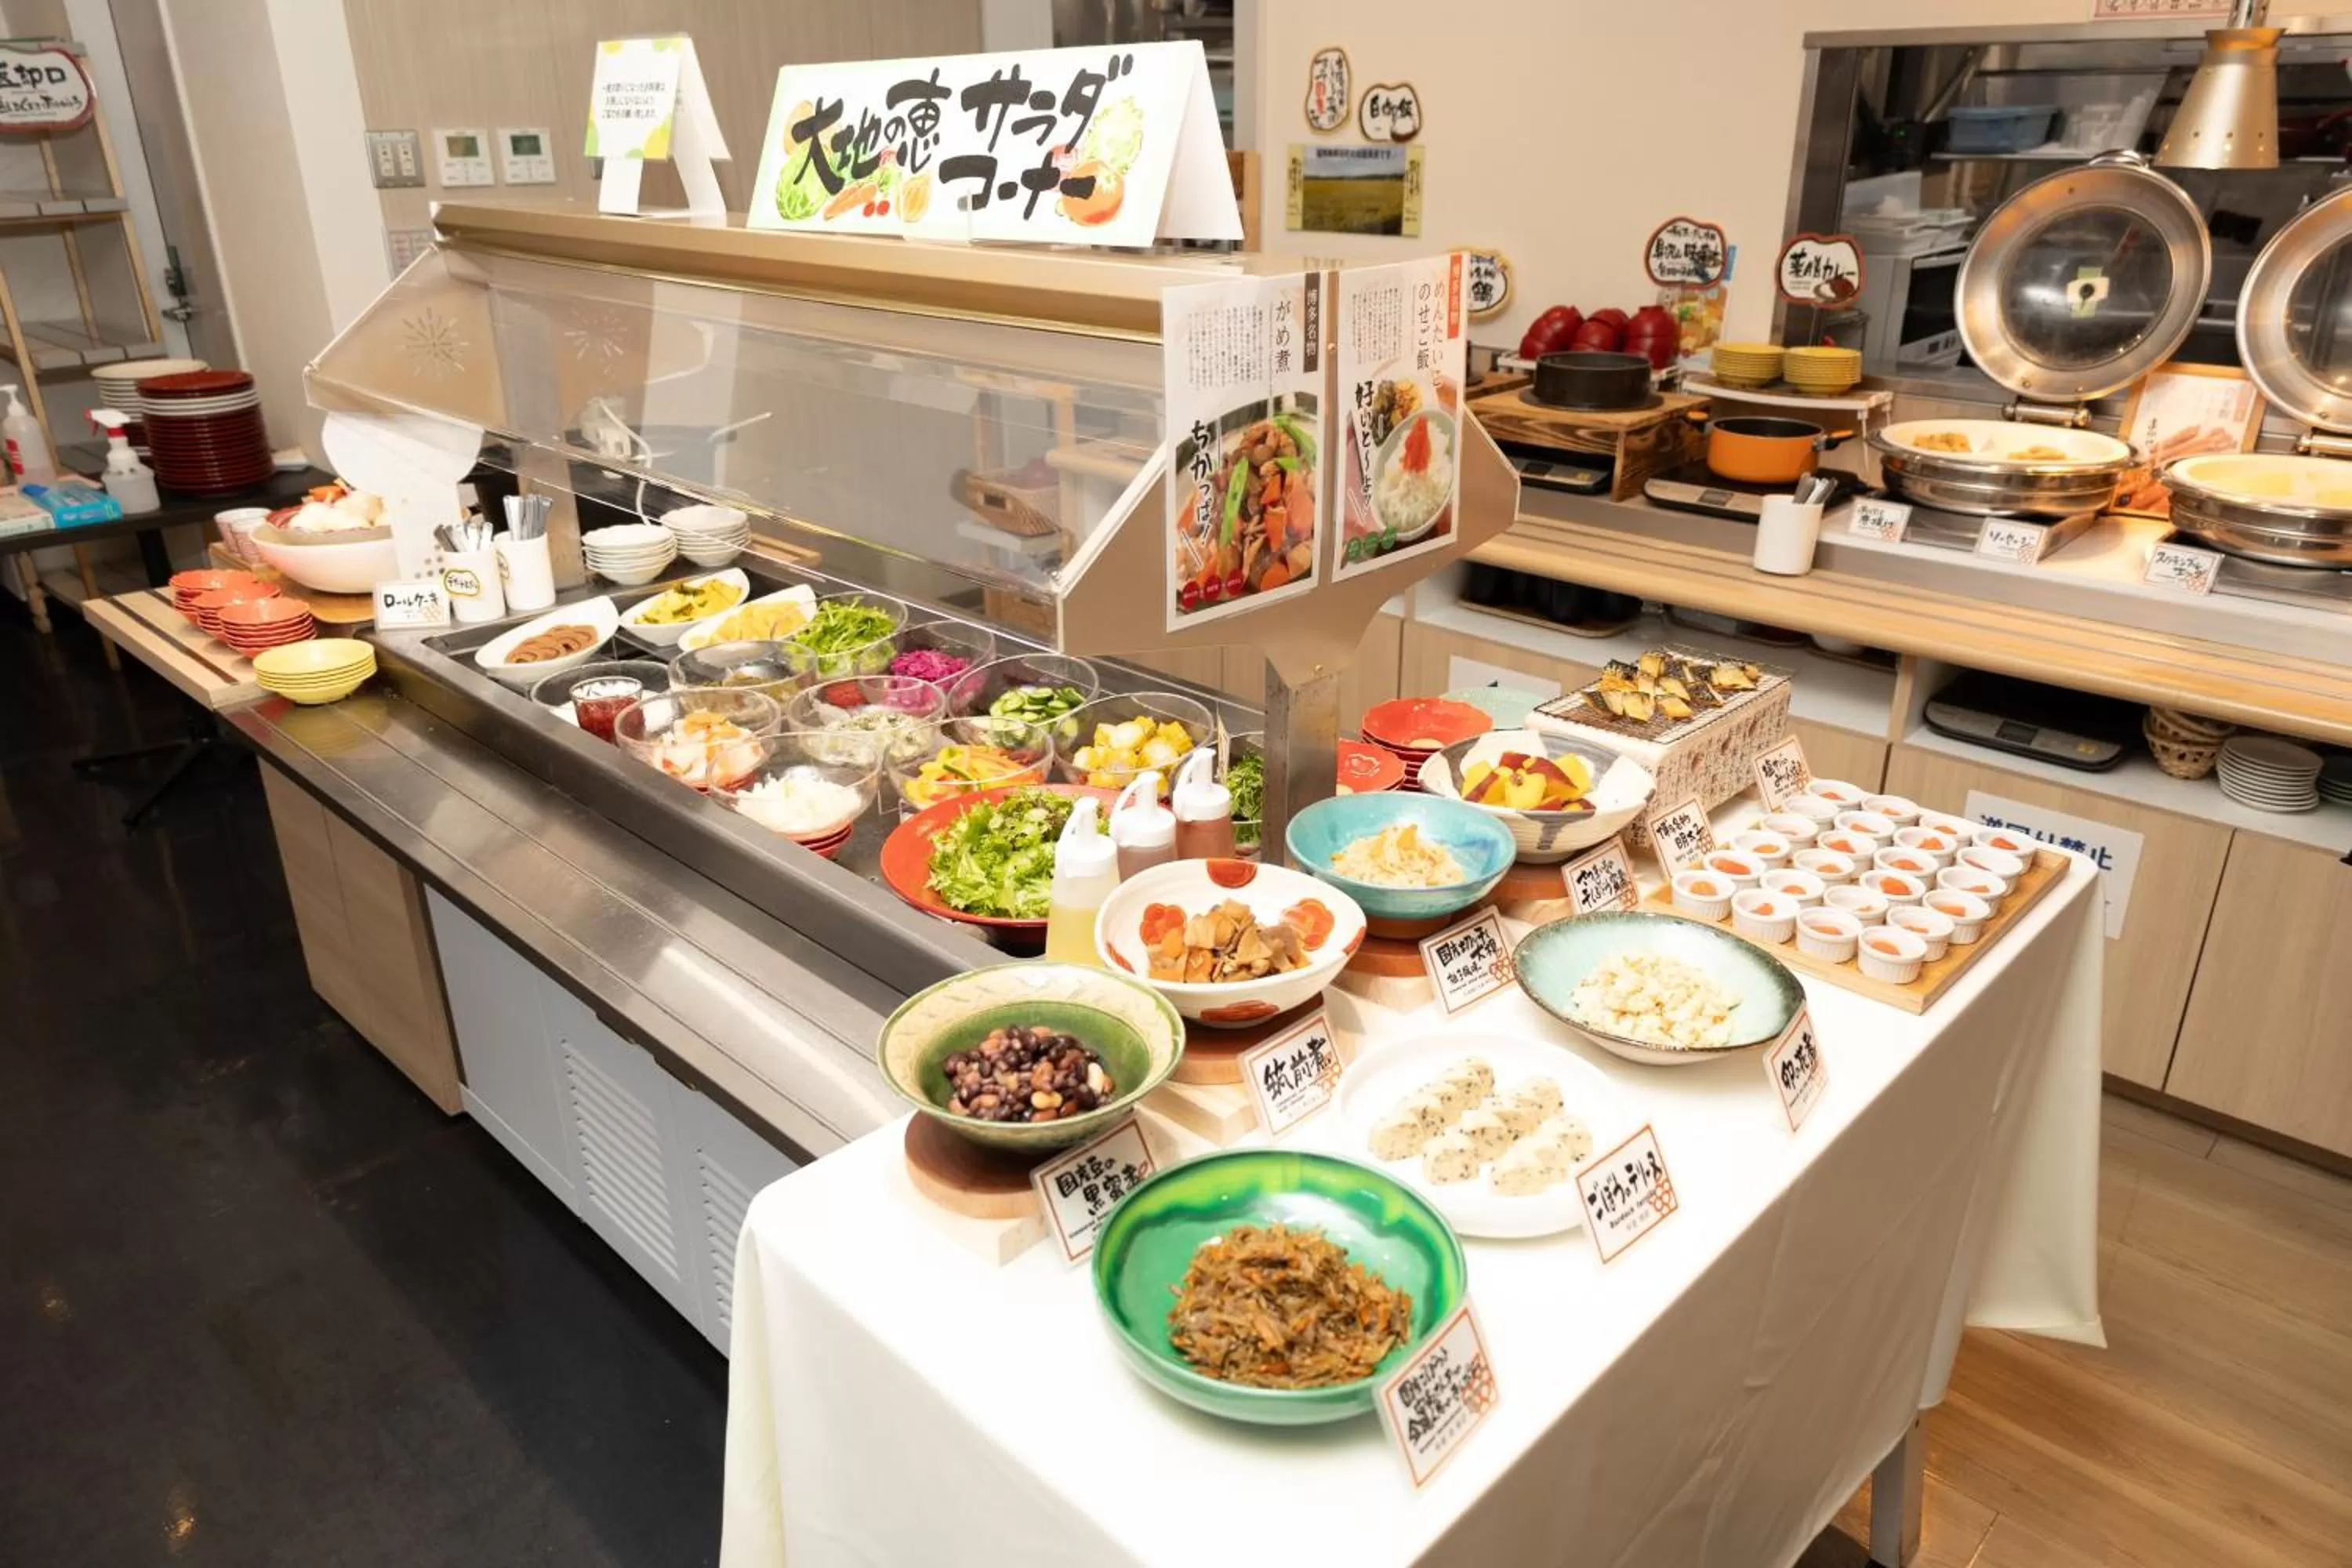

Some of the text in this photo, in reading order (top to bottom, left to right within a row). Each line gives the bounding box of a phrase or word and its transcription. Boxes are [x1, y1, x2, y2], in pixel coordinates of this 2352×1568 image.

[791, 53, 1134, 195] 大地の恵 サラダ
[939, 154, 1096, 220] コーナー
[1276, 300, 1292, 375] がめ煮
[1417, 283, 1432, 370] のせご飯
[1264, 1035, 1331, 1101] 筑前煮
[1054, 1156, 1116, 1199] 国産豆の
